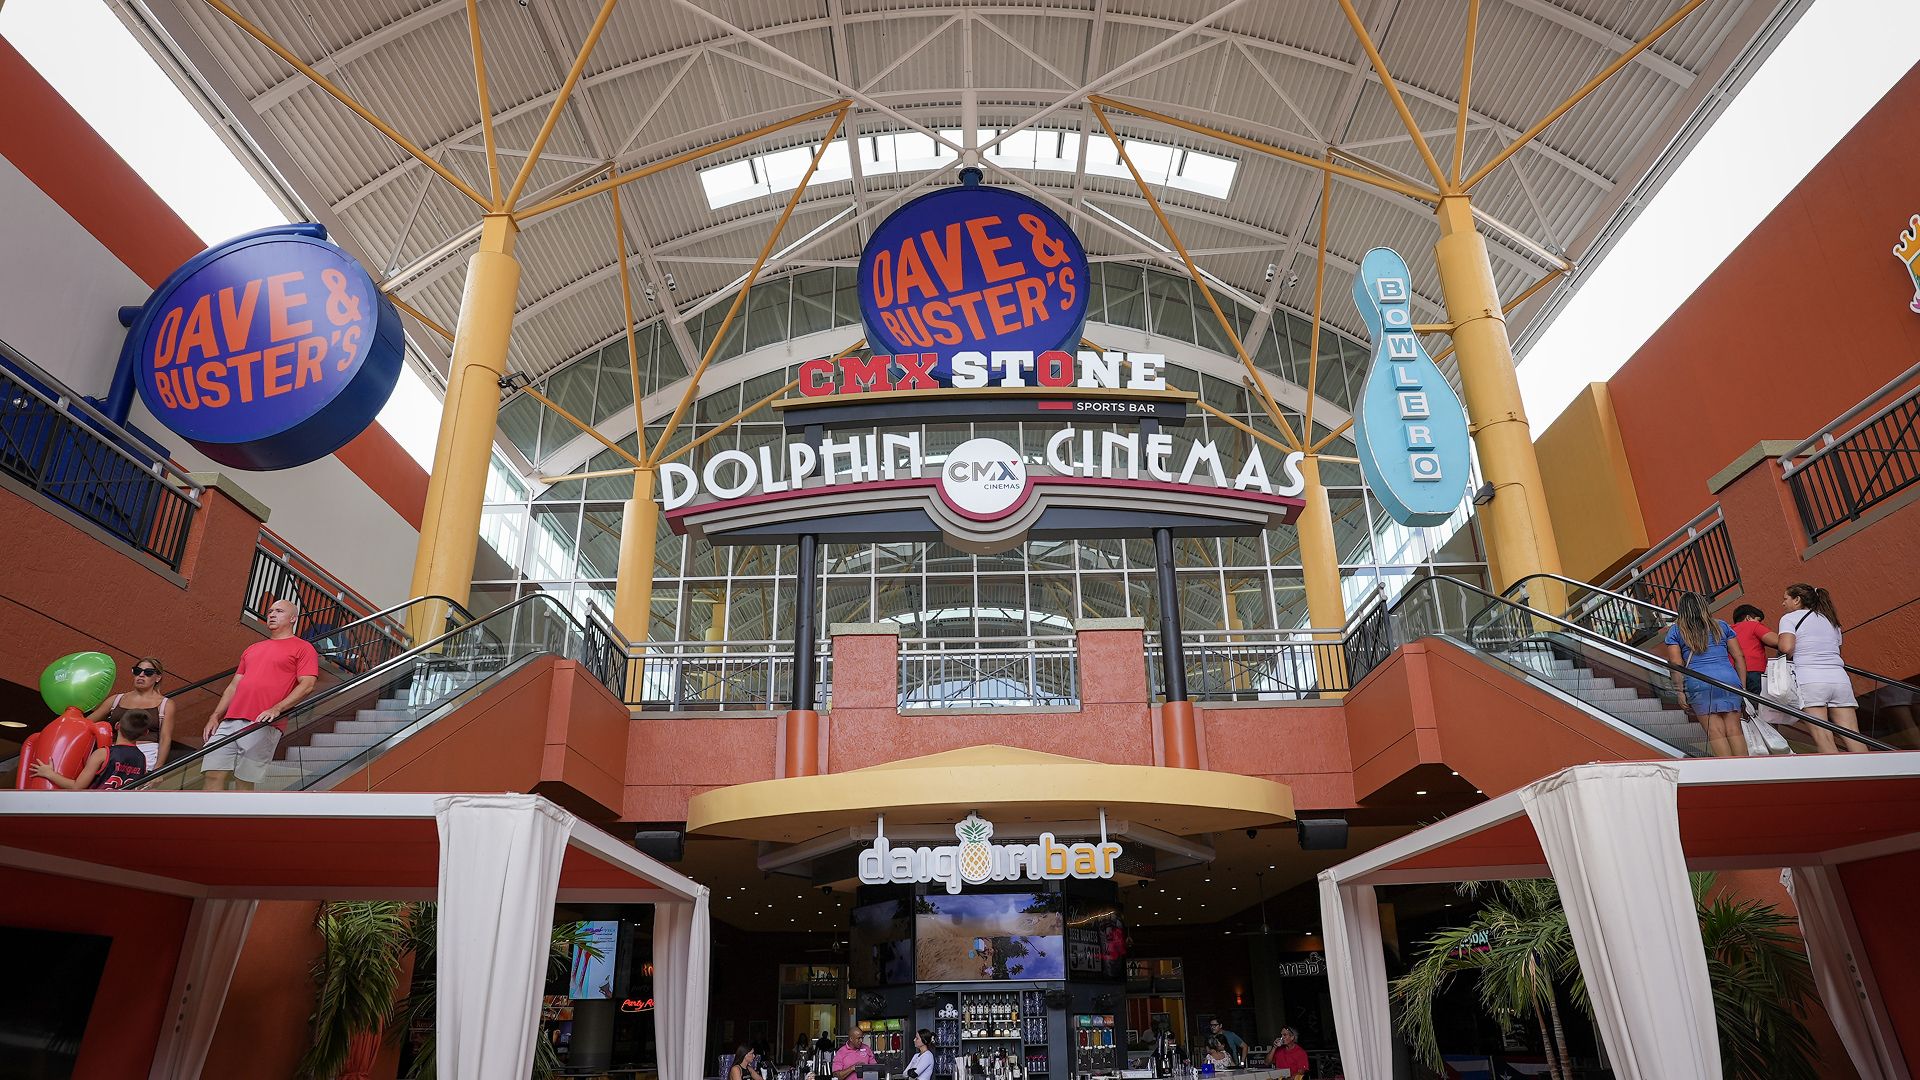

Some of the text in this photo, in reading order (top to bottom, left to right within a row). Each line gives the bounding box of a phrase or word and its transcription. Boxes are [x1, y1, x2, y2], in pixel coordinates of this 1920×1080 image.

[872, 213, 1072, 309] DAVE &
[154, 268, 362, 369] DAVE &
[879, 266, 1076, 348] BUSTER'S
[154, 326, 361, 411] BUSTER'S
[798, 350, 1167, 398] CMX STONE
[1076, 402, 1155, 413] SPORTS BAR
[1379, 280, 1440, 477] BOWLERO
[659, 430, 1306, 511] DOLPHIN CINEMAS
[948, 460, 1020, 483] CMX
[622, 999, 645, 1011] Party
